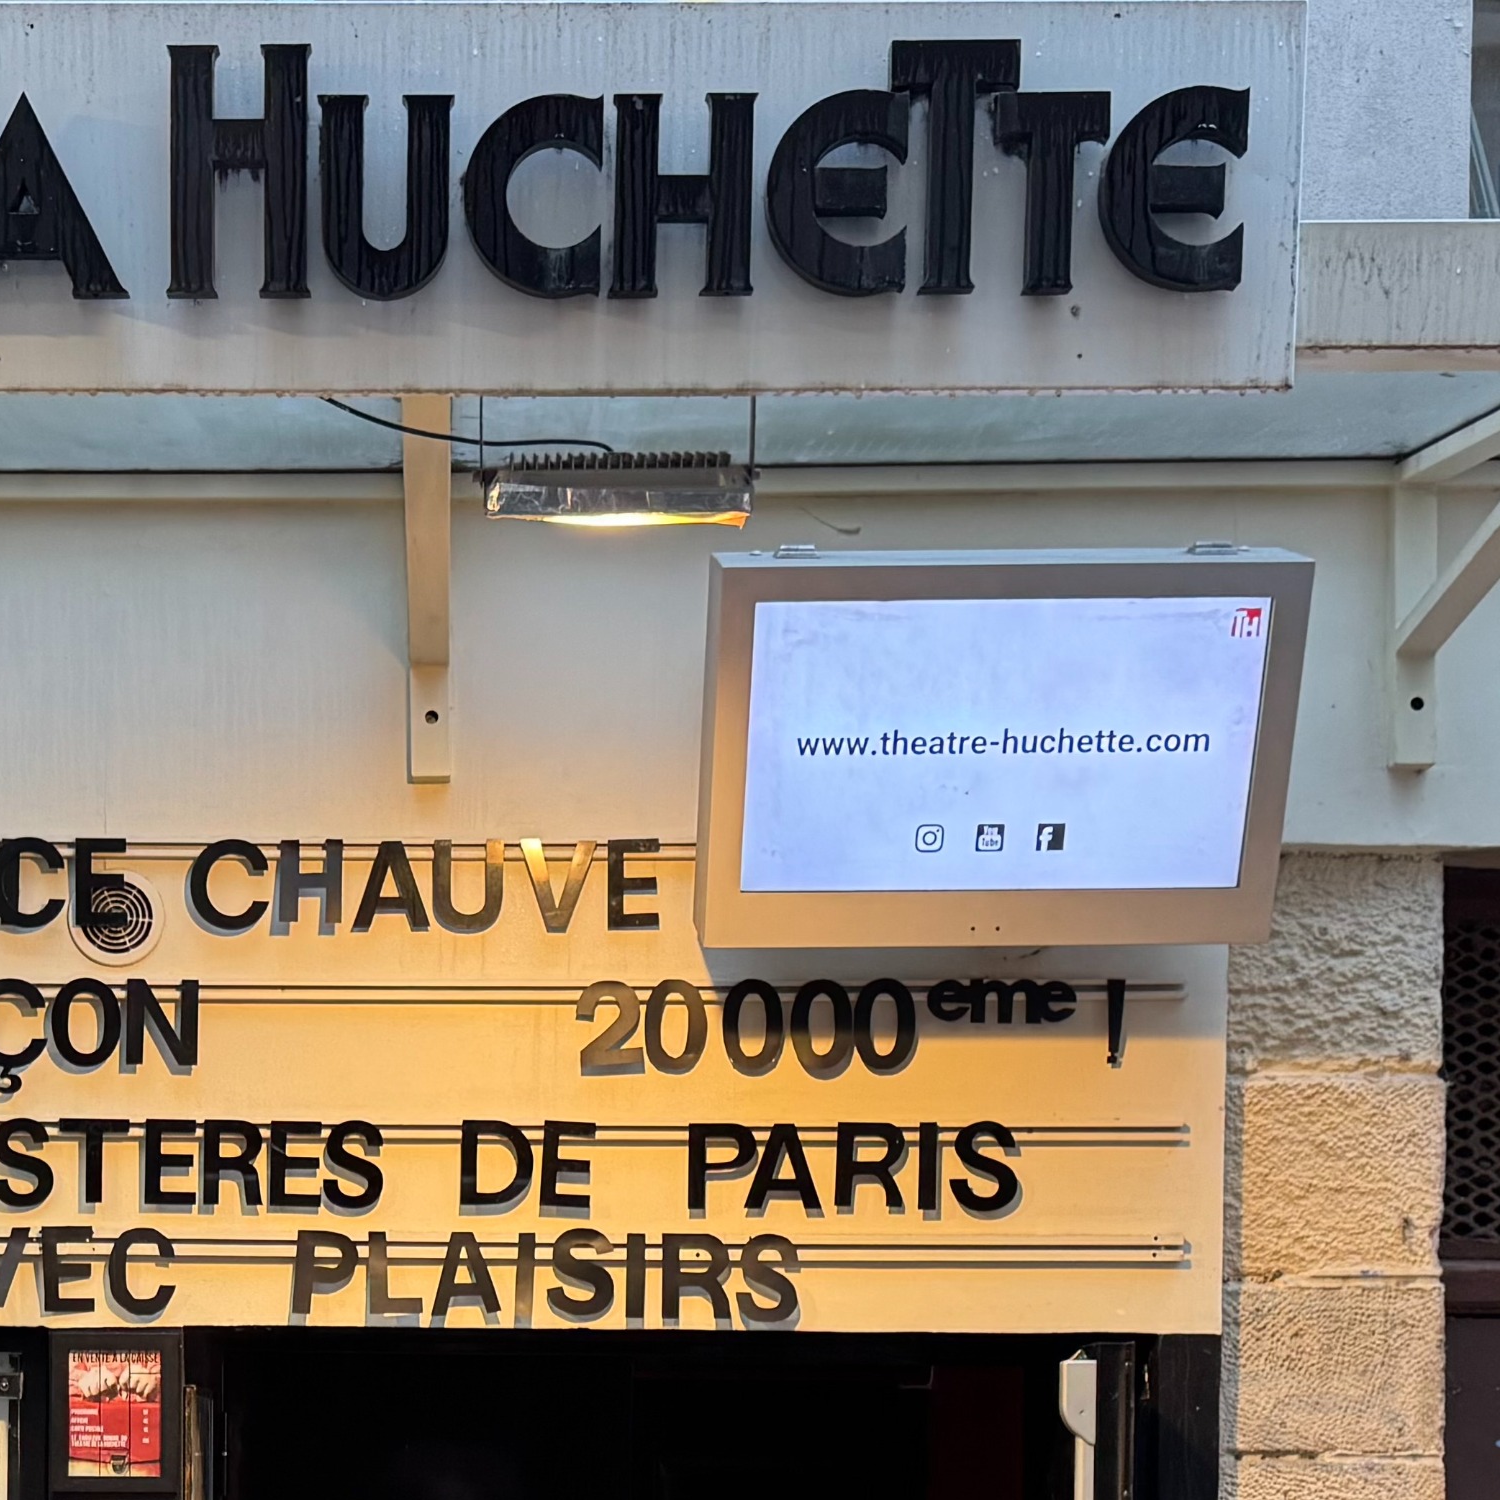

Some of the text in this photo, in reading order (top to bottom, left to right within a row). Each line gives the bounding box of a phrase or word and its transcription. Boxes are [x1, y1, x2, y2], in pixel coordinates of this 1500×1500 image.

[167, 39, 1251, 300] HUCHETTE
[797, 729, 1211, 756] www.theatre-huchette.com
[189, 838, 659, 934] CHAUVE
[459, 1119, 596, 1208] DE
[687, 1120, 1019, 1213] PARIS
[292, 1228, 799, 1323] PLAISIRS
